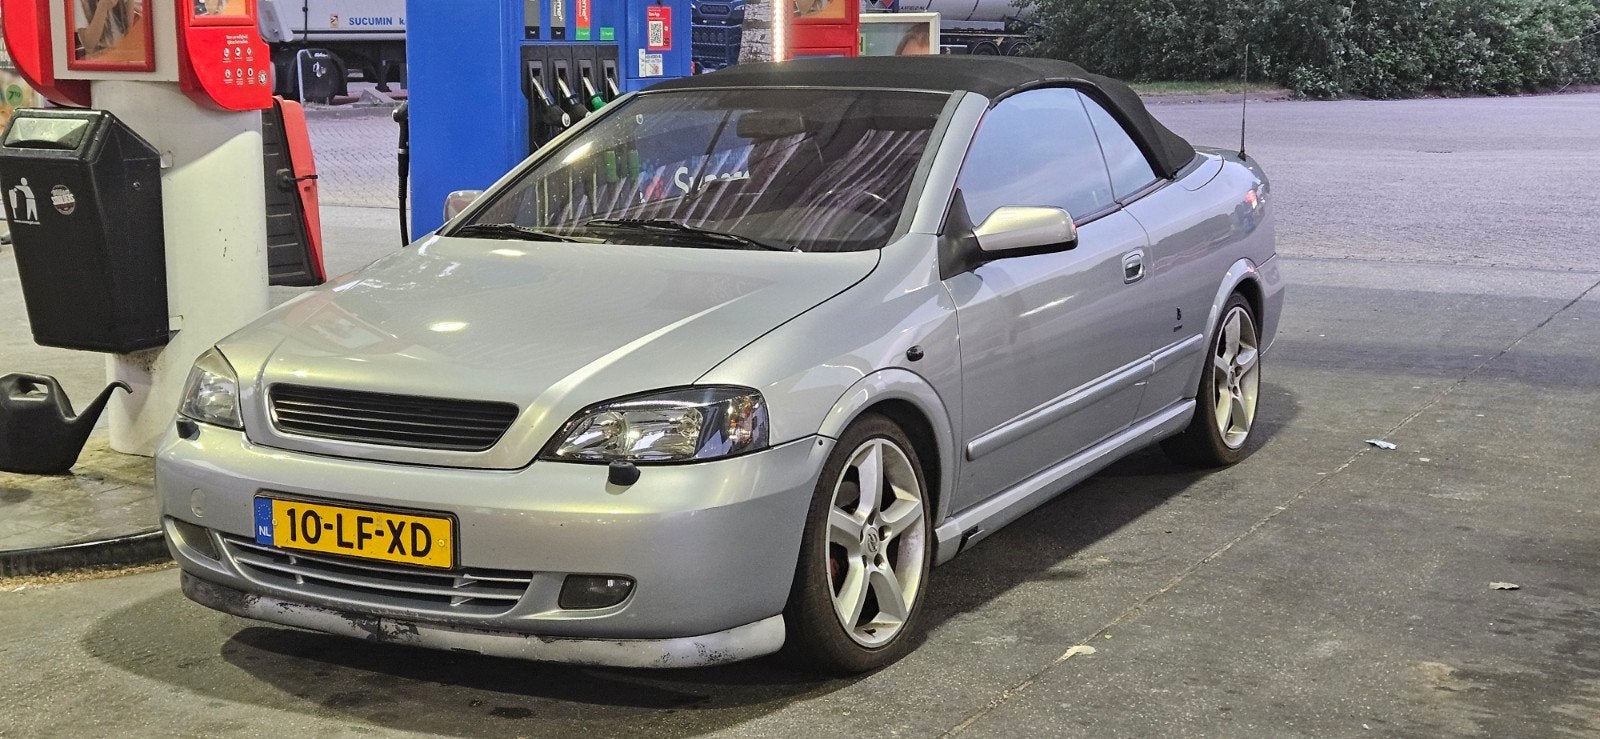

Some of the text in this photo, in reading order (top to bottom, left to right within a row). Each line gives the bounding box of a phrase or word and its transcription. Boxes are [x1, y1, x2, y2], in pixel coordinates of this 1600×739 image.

[349, 17, 393, 26] SUCUMIN
[259, 525, 272, 538] NL
[287, 508, 432, 558] 10-LF-XD
